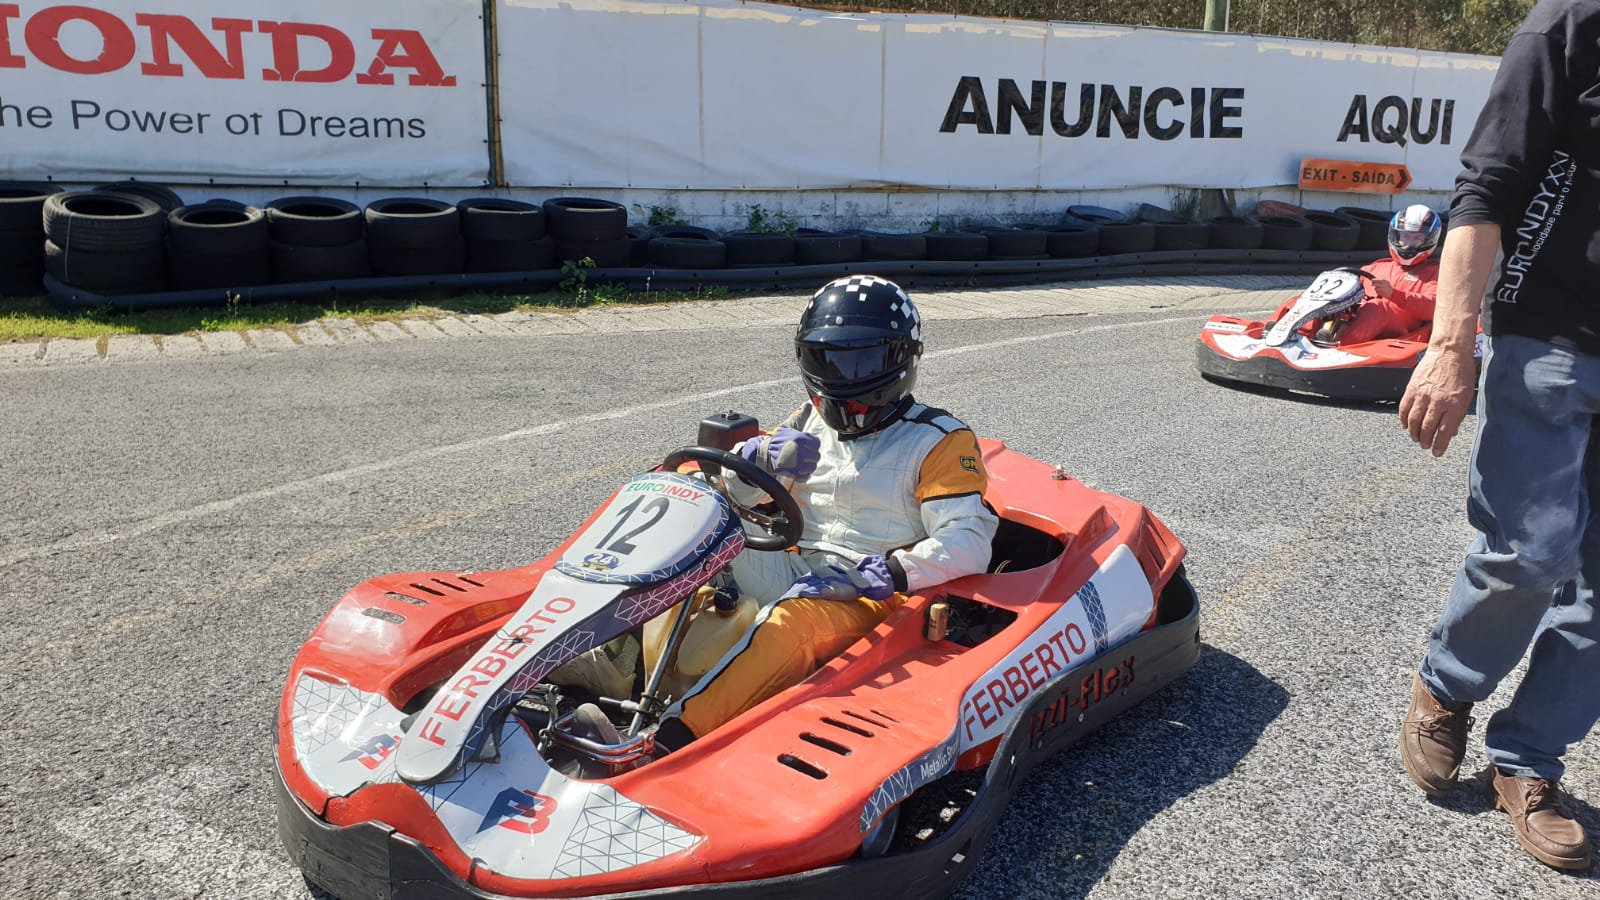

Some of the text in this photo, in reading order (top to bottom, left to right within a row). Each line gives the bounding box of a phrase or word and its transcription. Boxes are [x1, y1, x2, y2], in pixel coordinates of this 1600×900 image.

[0, 3, 457, 87] ONDA
[71, 99, 211, 135] Power
[278, 108, 427, 139] Dreams
[938, 75, 1246, 141] ANUNCIE
[1336, 93, 1456, 149] AQUI
[1302, 167, 1339, 182] EXIT
[1351, 168, 1395, 186] SAÍDA
[1309, 278, 1344, 295] 32
[626, 482, 705, 502] EUROINDY
[595, 494, 671, 557] 12
[418, 596, 577, 747] FERBERTO
[963, 622, 1087, 743] FERBERTO
